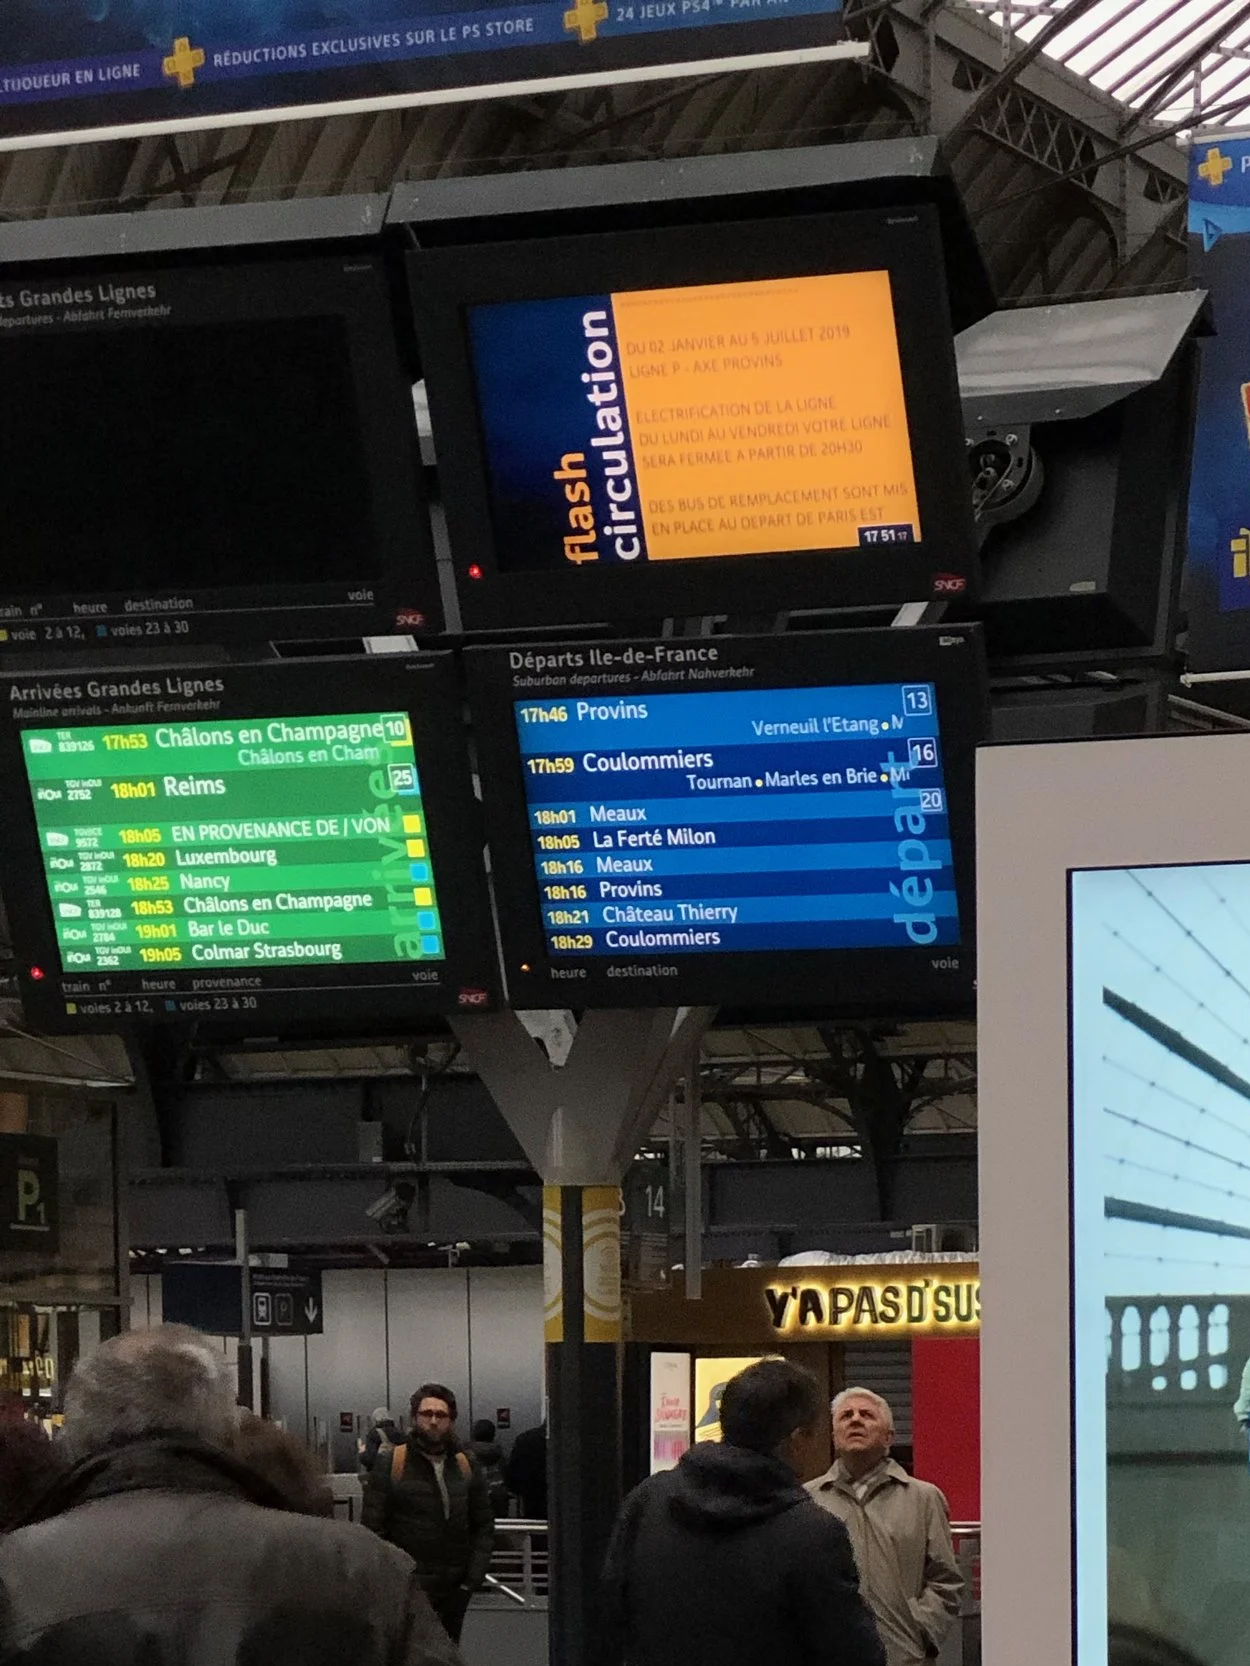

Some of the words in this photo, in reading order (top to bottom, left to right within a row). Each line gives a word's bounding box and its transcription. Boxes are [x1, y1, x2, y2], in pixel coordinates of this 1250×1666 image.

[617, 7, 634, 21] 24
[640, 3, 676, 19] JEUX
[213, 44, 307, 67] RÉDUCTIONS
[312, 33, 401, 57] EXCLUSIVES
[406, 30, 435, 46] SUR
[440, 27, 456, 42] LE
[462, 25, 481, 39] PS
[486, 18, 534, 37] STORE
[75, 69, 93, 84] EN
[99, 63, 141, 81] LIGNE
[581, 309, 641, 561] circulation
[552, 451, 599, 565] flash
[864, 530, 878, 543] 17
[882, 529, 896, 542] 51
[509, 651, 584, 672] Départs
[590, 647, 719, 666] Ile-de-France
[10, 684, 82, 701] Arrivées
[87, 680, 161, 697] Grandes
[166, 677, 225, 696] Lignes
[520, 706, 568, 723] 17h46
[577, 700, 648, 721] Provins
[906, 691, 929, 709] 13
[102, 733, 149, 750] 17h53
[155, 726, 234, 748] Châlons
[238, 730, 262, 744] en
[267, 720, 383, 746] Champagne
[385, 720, 405, 737] 10
[752, 718, 819, 736] Verneuil
[527, 757, 575, 775] 17h59
[583, 749, 714, 772] Coulommiers
[912, 744, 934, 761] 16
[110, 782, 156, 799] 18h01
[163, 776, 226, 797] Reims
[392, 769, 413, 786] 25
[687, 774, 752, 791] Tournan
[765, 769, 819, 788] Marles
[823, 772, 842, 785] en
[846, 768, 877, 784] Brie
[534, 810, 577, 825] 18h01
[590, 806, 648, 823] Meaux
[922, 791, 941, 808] 20
[118, 828, 162, 844] 18h05
[171, 824, 195, 842] EN
[199, 820, 312, 842] PROVENANCE
[316, 819, 338, 837] DE
[352, 816, 391, 835] VON
[537, 835, 581, 850] 18h05
[593, 831, 613, 849] La
[617, 829, 663, 847] Ferté
[667, 828, 716, 846] Milon
[123, 852, 166, 868] 18h20
[175, 847, 278, 867] Luxembourg
[880, 751, 943, 945] départ
[541, 860, 584, 875] 18h16
[596, 857, 654, 874] Meaux
[128, 876, 170, 892] 18h25
[179, 872, 231, 893] Nancy
[544, 885, 587, 900] 18h16
[599, 880, 663, 899] Provins
[131, 899, 174, 915] 18h53
[184, 895, 249, 914] Châlons
[252, 898, 272, 911] en
[275, 890, 373, 913] Champagne
[547, 910, 590, 925] 18h21
[602, 906, 674, 923] Château
[677, 903, 738, 923] Thierry
[135, 923, 178, 939] 19h01
[188, 920, 214, 938] Bar
[219, 919, 233, 935] le
[237, 918, 270, 936] Duc
[550, 935, 593, 950] 18h29
[606, 928, 721, 948] Coulommiers
[139, 947, 182, 963] 19h05
[192, 943, 251, 961] Colmar
[253, 941, 343, 961] Strasbourg
[551, 967, 587, 980] heure
[606, 964, 678, 978] destination
[932, 957, 960, 969] voie
[645, 1184, 665, 1218] 14
[907, 1279, 980, 1323] D'SU
